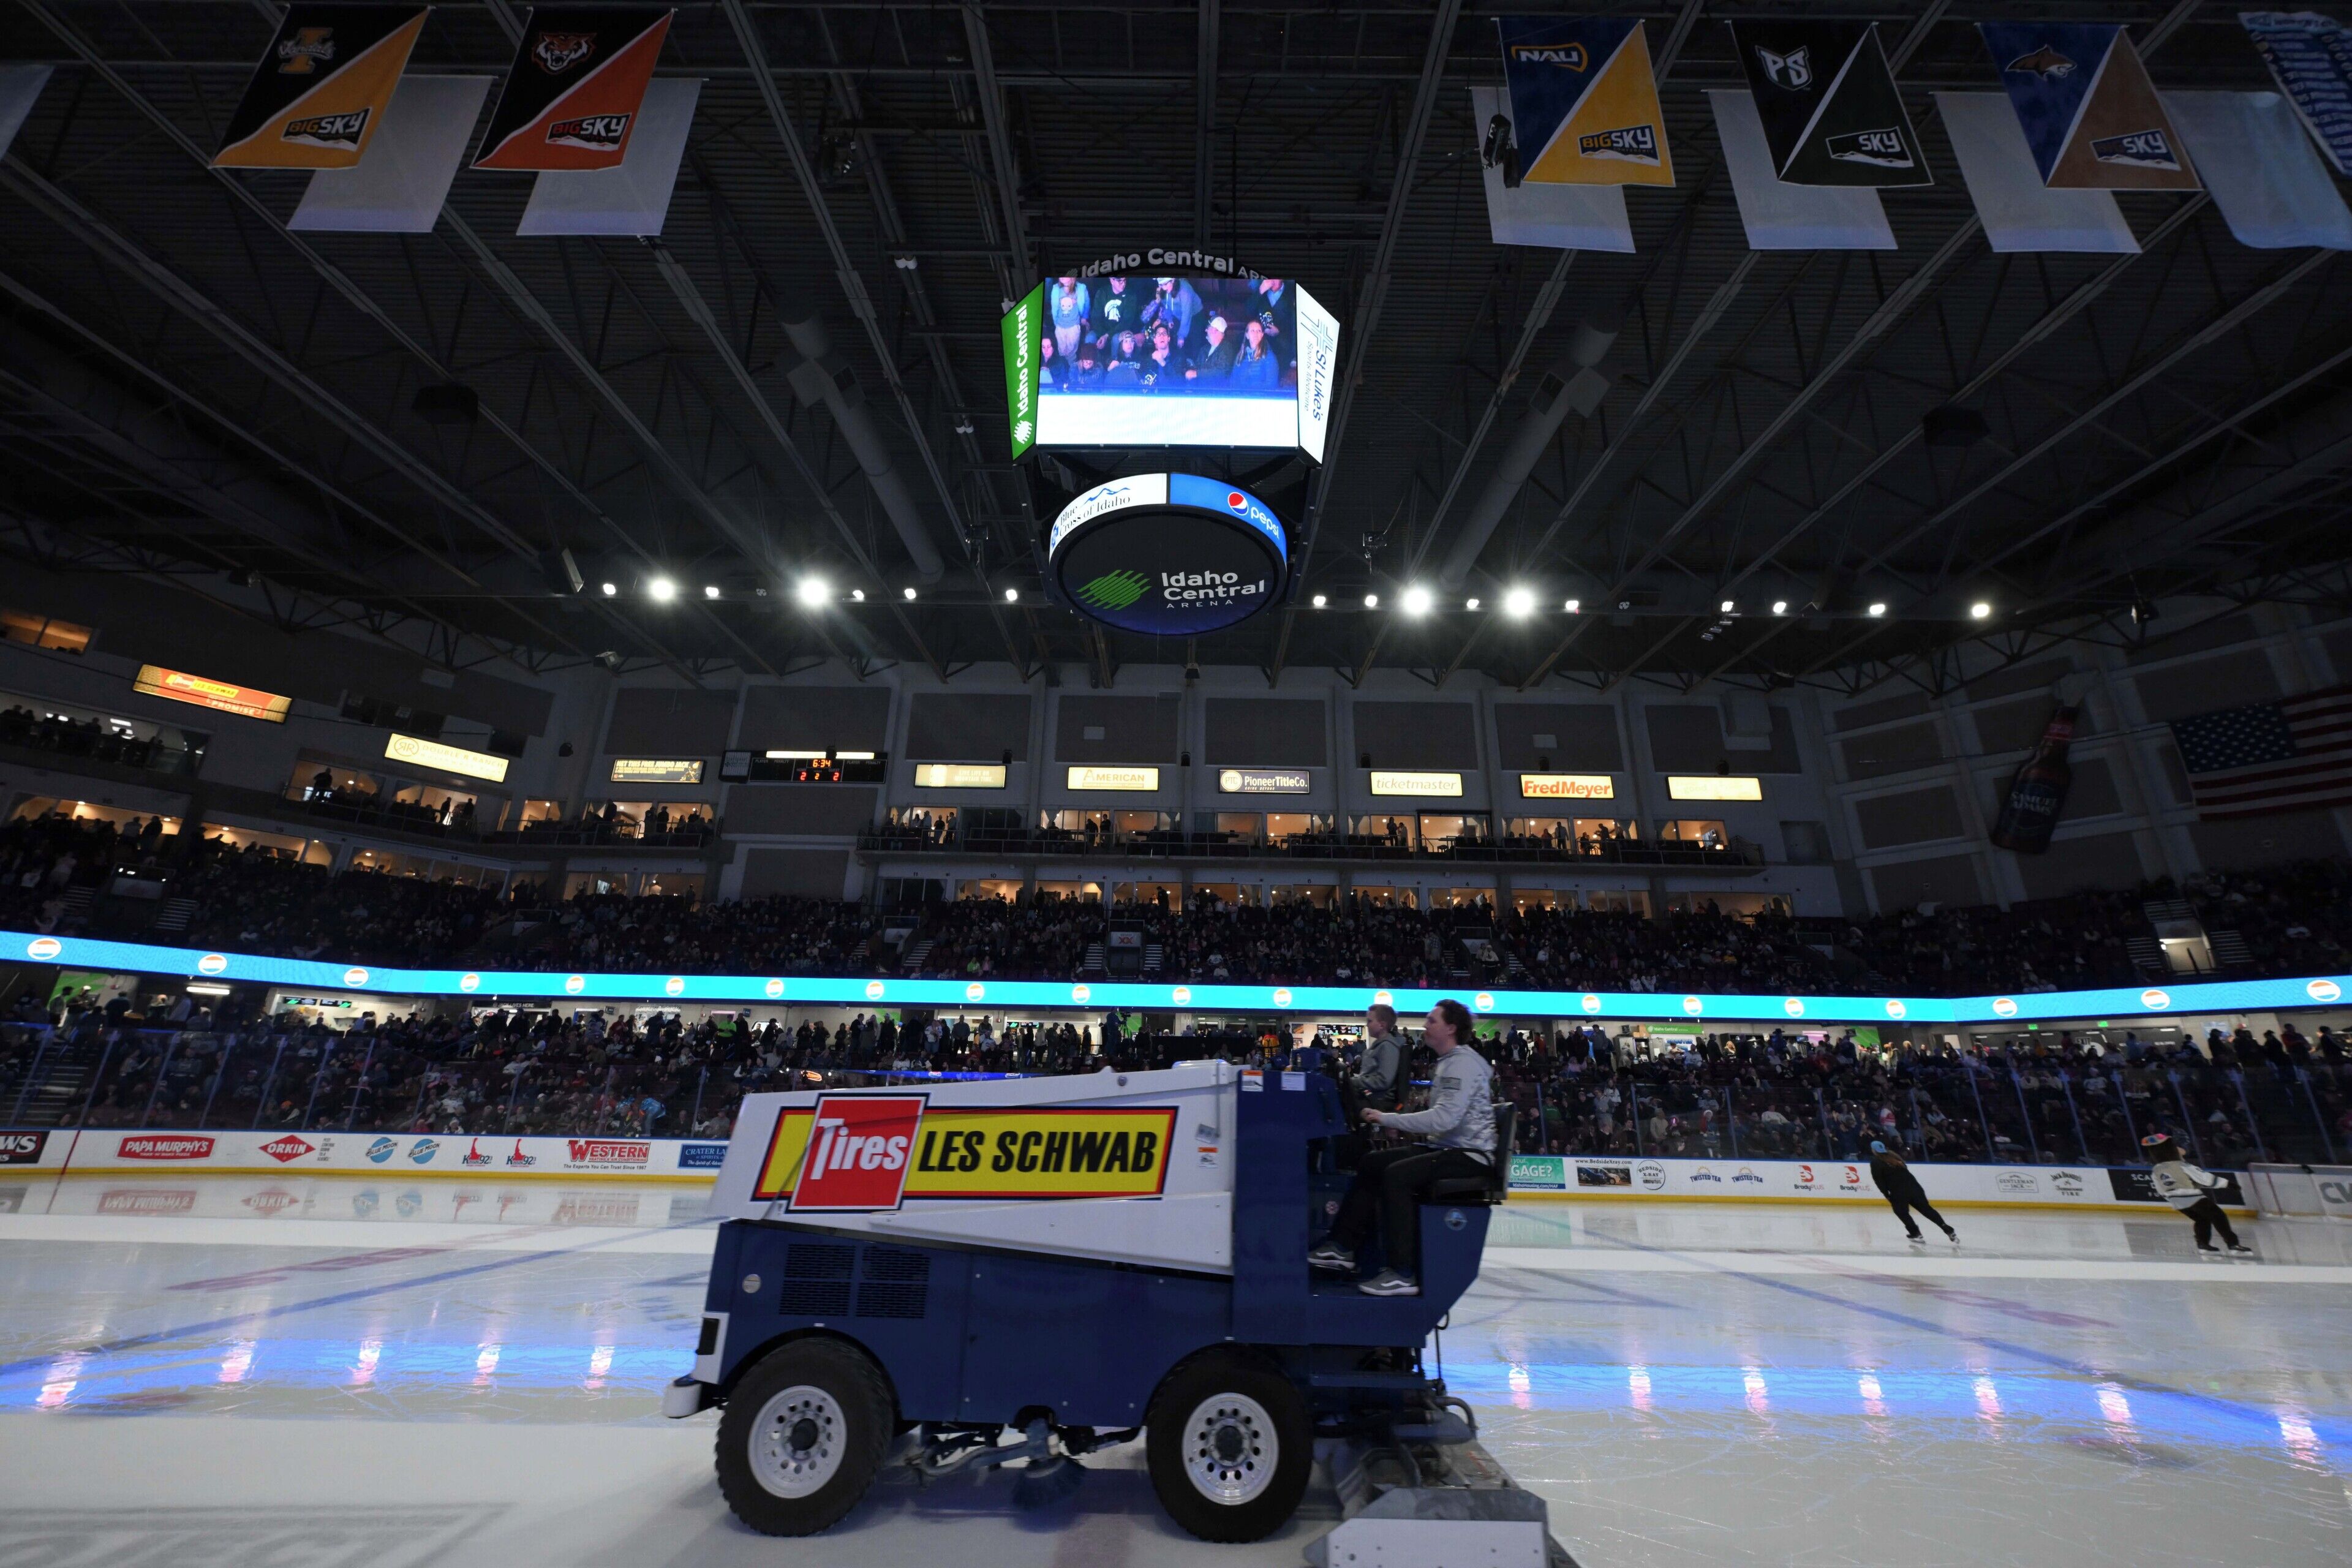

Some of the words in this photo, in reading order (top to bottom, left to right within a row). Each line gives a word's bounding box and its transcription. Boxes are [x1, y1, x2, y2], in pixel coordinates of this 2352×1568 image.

[1518, 50, 1579, 62] NAU
[1758, 50, 1807, 86] PS
[1081, 254, 1141, 277] Idaho
[1147, 248, 1234, 273] Central
[1016, 304, 1028, 368] Central
[1017, 368, 1028, 418] Idaho
[1059, 514, 1081, 537] Cross
[1084, 504, 1095, 518] of
[1096, 496, 1131, 512] Idaho
[1060, 506, 1078, 526] Blue
[1161, 570, 1238, 587] Idaho
[1163, 579, 1265, 600] Central
[1166, 599, 1233, 609] ARENA
[212, 701, 255, 715] PROMISE
[422, 744, 459, 758] DOUBLE
[812, 759, 831, 768] 6:34
[800, 771, 807, 781] 2
[832, 772, 840, 781] 2
[1083, 769, 1145, 782] AMERICAN
[1376, 778, 1457, 790] ticketmaster
[1524, 780, 1560, 794] Fred
[1561, 781, 1610, 798] Meyer
[125, 1140, 153, 1152] PAPA
[154, 1141, 208, 1153] MURPHY'S
[267, 1143, 307, 1155] ORKIN
[382, 1142, 399, 1150] MOON
[424, 1142, 440, 1152] MOON
[567, 1139, 650, 1161] WESTERN
[810, 1117, 909, 1180] Tires
[917, 1131, 985, 1173] LES
[992, 1131, 1158, 1173] SCHWAB
[1638, 1166, 1663, 1174] BEDSIDE
[1690, 1174, 1711, 1183] TWISTED
[1731, 1174, 1753, 1183] TWISTED
[1753, 1175, 1763, 1183] TEA
